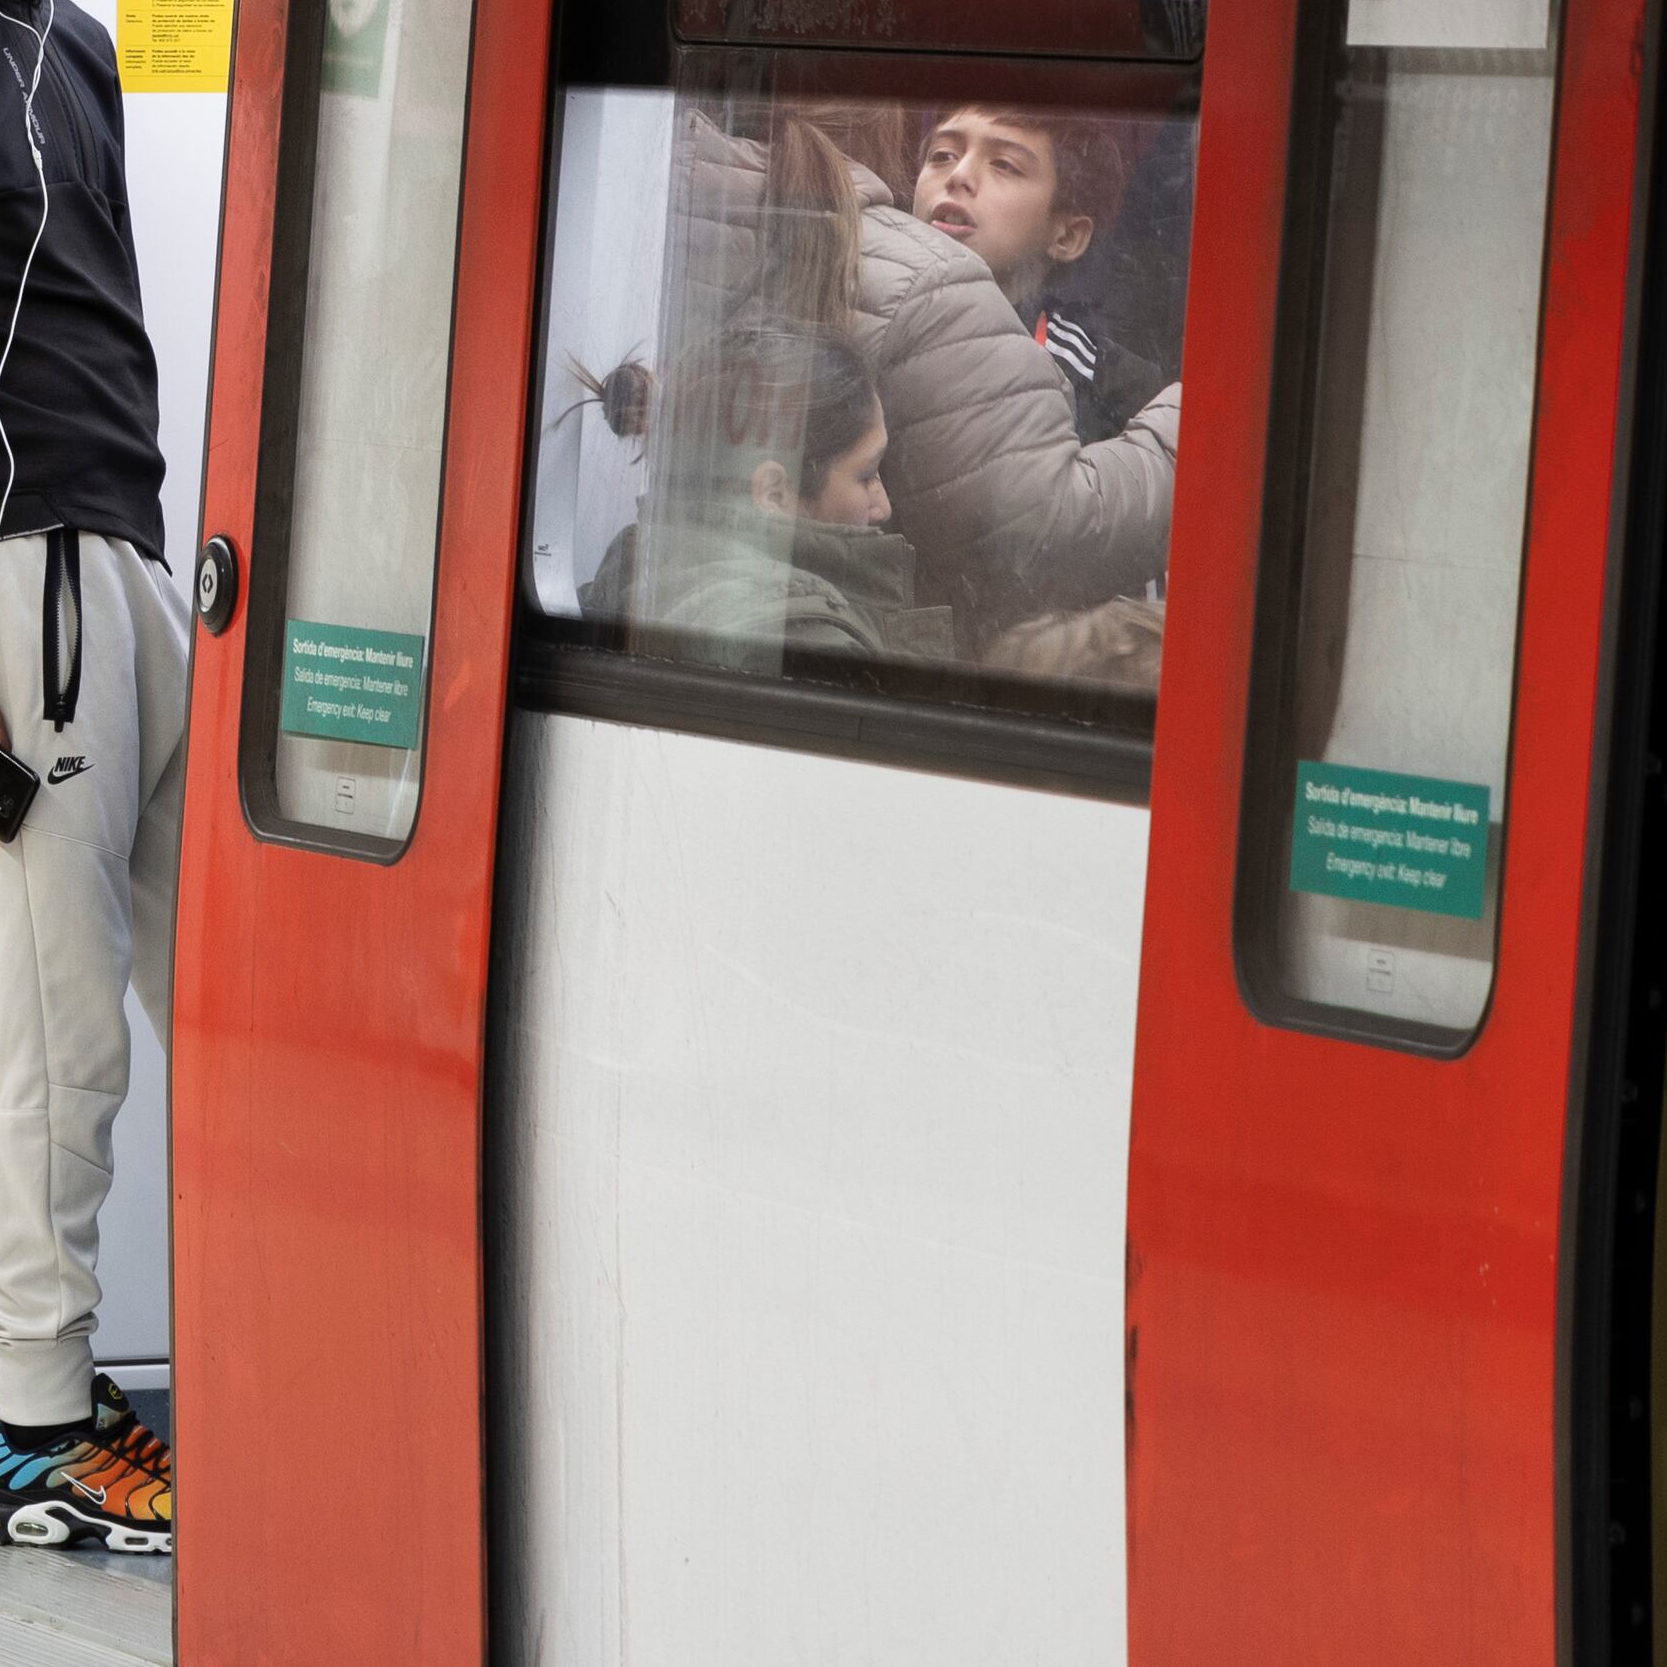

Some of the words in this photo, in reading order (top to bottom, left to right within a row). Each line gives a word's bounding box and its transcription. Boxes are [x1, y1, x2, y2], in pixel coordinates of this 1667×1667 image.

[3, 47, 25, 88] UNDER
[292, 638, 317, 656] Sortida
[365, 647, 396, 666] Mantenir
[396, 651, 414, 669] lliure
[307, 696, 341, 719] Emergency
[357, 703, 374, 724] Keep
[374, 707, 391, 723] clear
[54, 756, 86, 772] NIKE
